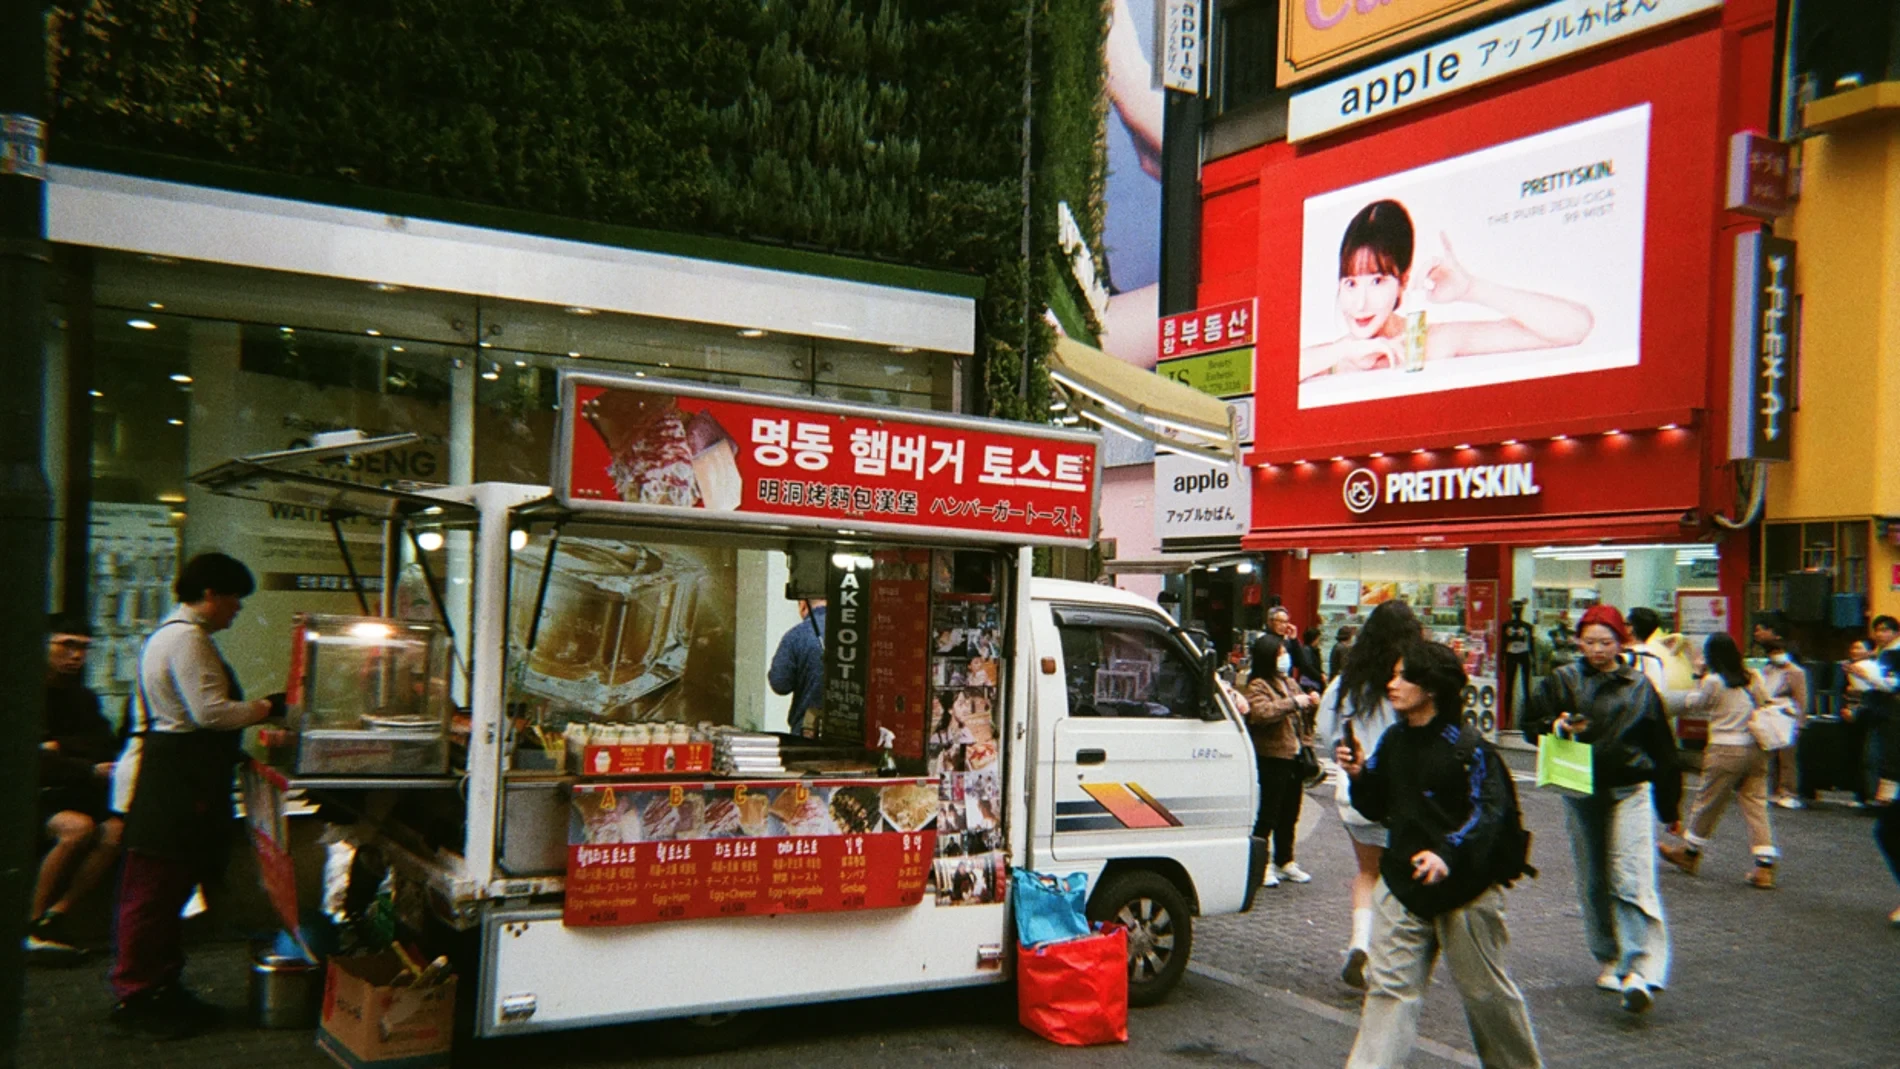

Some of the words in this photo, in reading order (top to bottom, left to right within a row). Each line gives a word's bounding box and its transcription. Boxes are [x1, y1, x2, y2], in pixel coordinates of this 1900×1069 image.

[1181, 3, 1195, 79] apple
[1341, 52, 1460, 115] apple
[1180, 308, 1249, 345] 부동산
[750, 418, 834, 470] 명동
[849, 428, 966, 482] 햄버거
[978, 446, 1087, 492] 토스트
[1174, 469, 1229, 493] apple
[930, 496, 1082, 529] ハンバーガートースト
[837, 629, 858, 679] OUT
[600, 787, 616, 810] A
[669, 784, 684, 807] B
[734, 783, 748, 805] C
